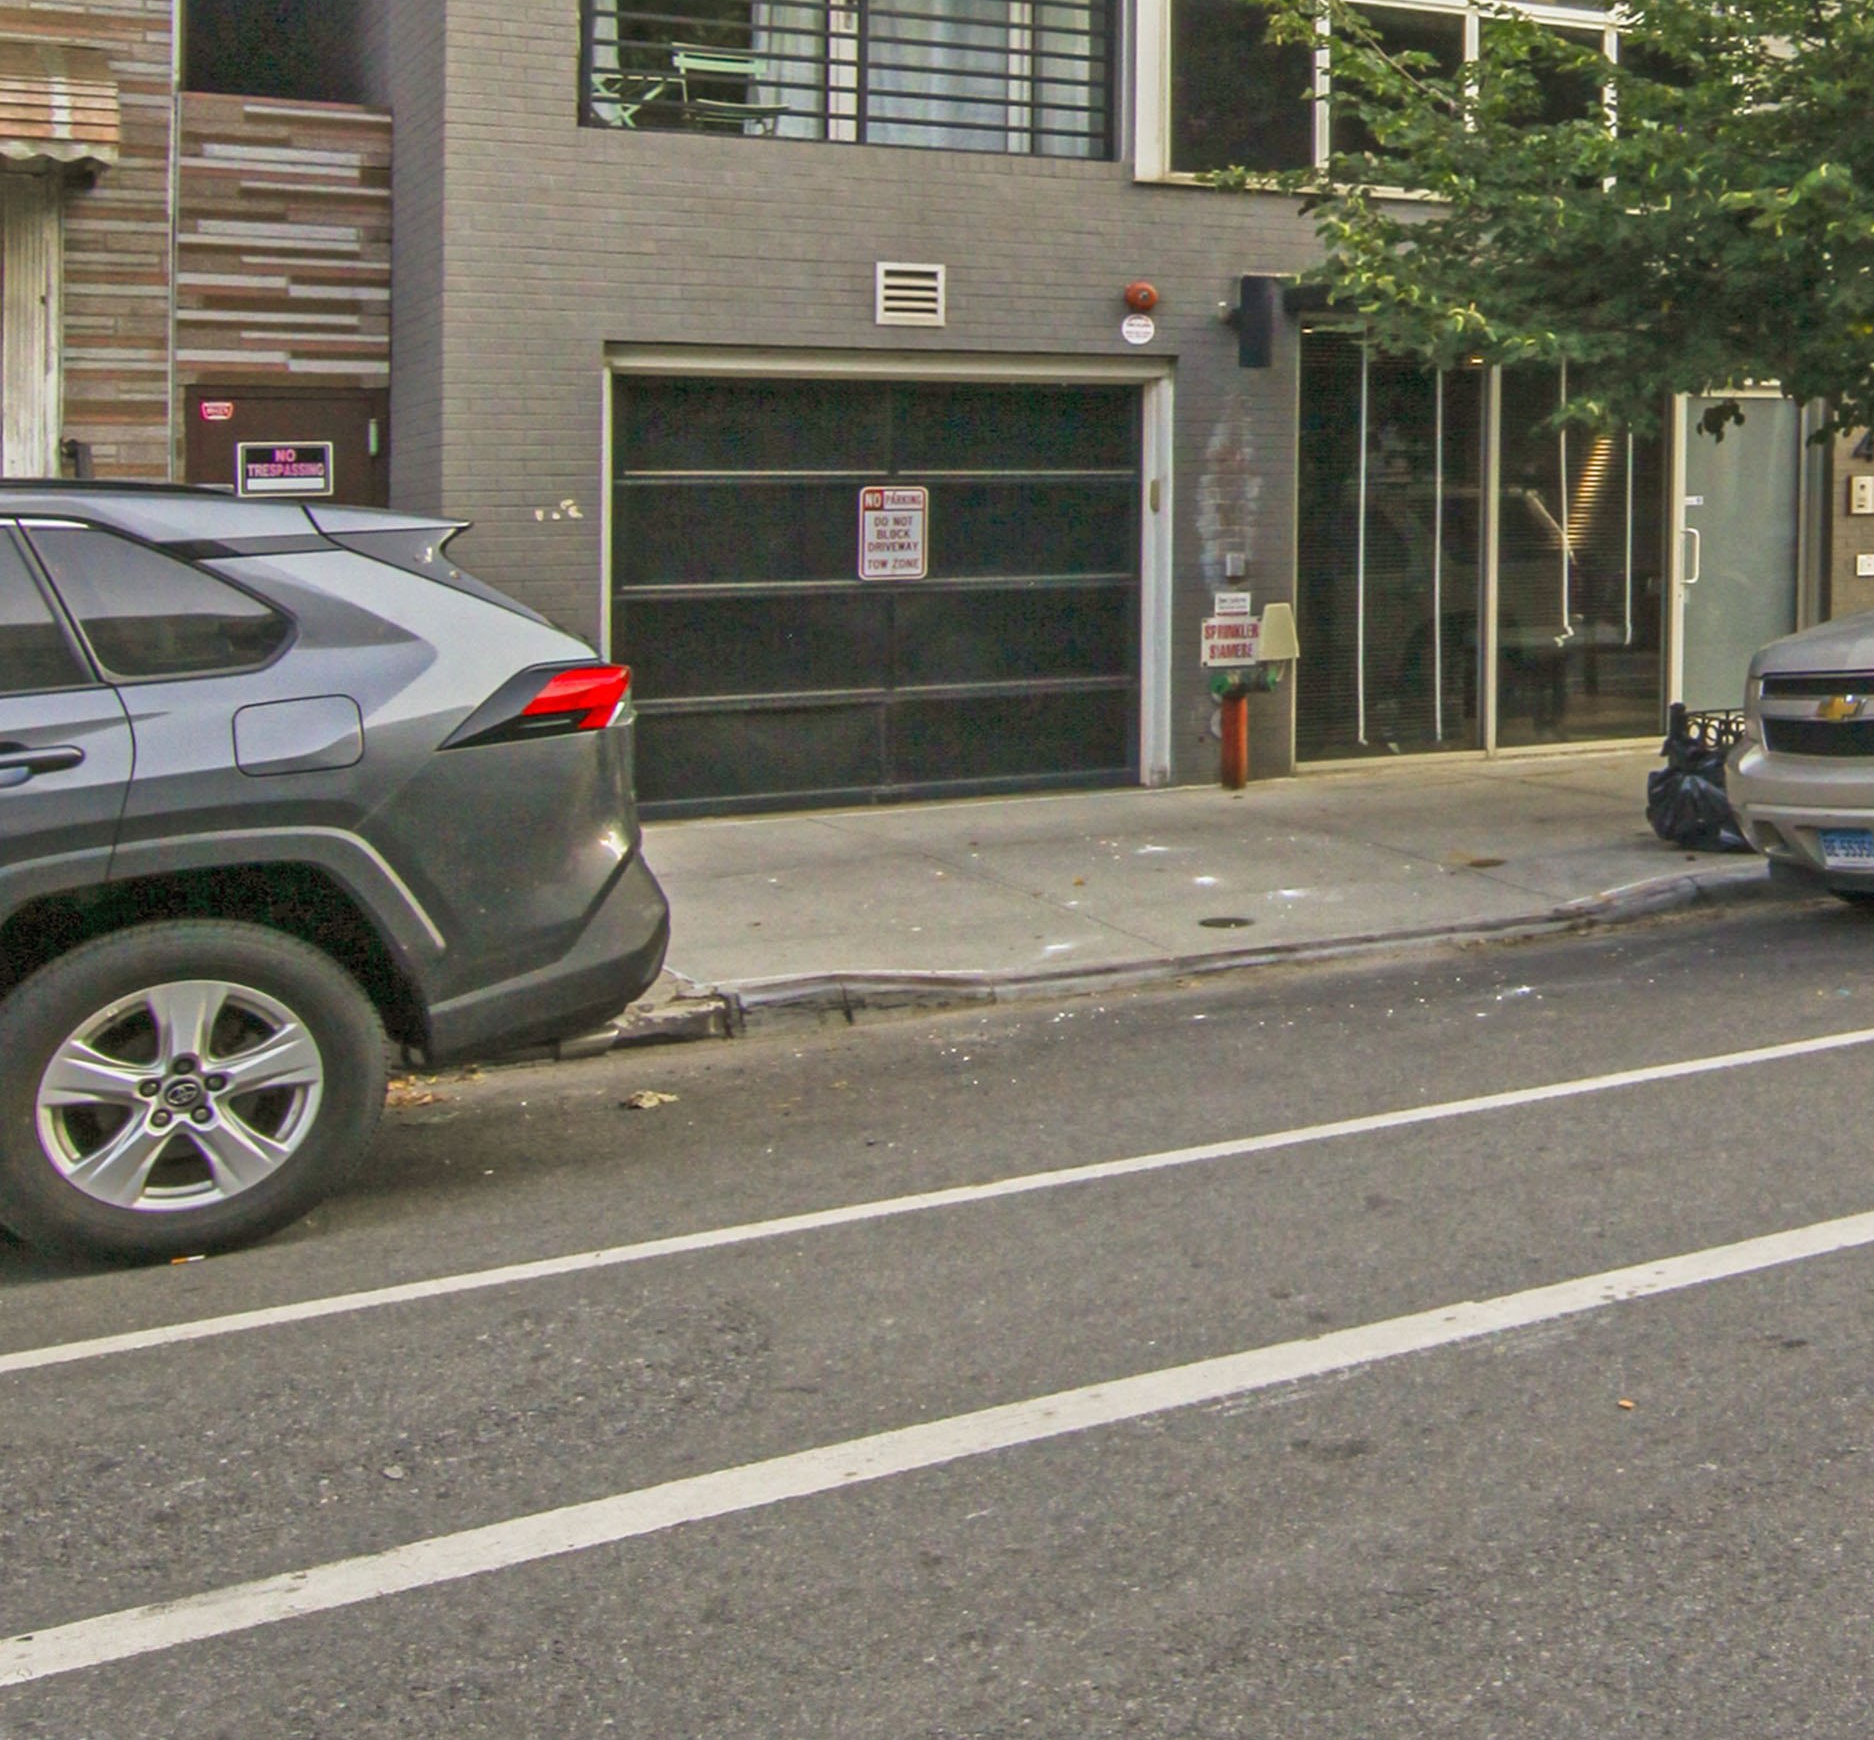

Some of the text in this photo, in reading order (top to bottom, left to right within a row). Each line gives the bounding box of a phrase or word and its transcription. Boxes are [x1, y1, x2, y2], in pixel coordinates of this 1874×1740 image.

[275, 449, 297, 462] NO
[247, 463, 325, 477] TRESPASSING
[865, 491, 922, 509] NO PARKING
[874, 516, 913, 527] DO NOT
[877, 529, 910, 540] BLOCK
[867, 542, 919, 552] DRIVEWAY
[867, 559, 919, 569] TOW ZONE
